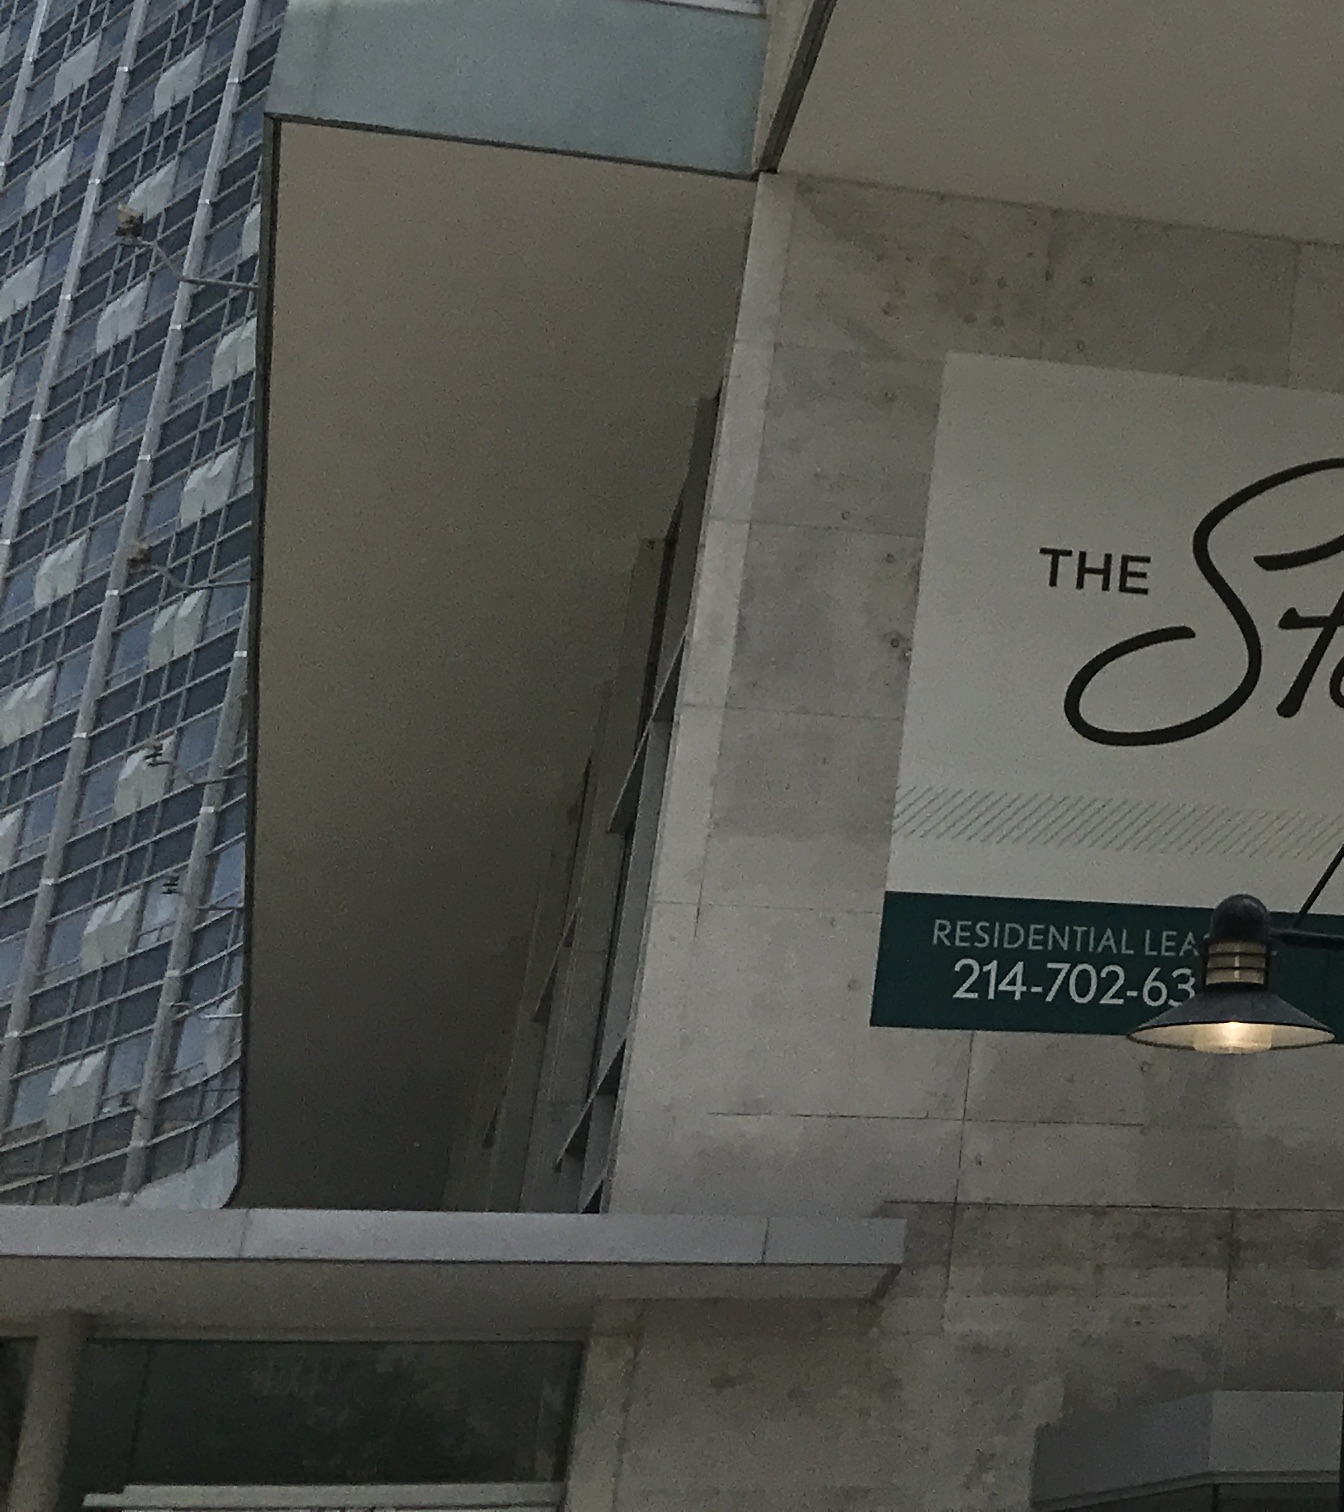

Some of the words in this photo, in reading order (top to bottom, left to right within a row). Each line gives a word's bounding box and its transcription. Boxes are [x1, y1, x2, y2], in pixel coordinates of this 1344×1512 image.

[1039, 546, 1152, 595] THE
[932, 918, 1135, 955] RESIDENTIAL
[952, 958, 1197, 1008] 214-702-63
